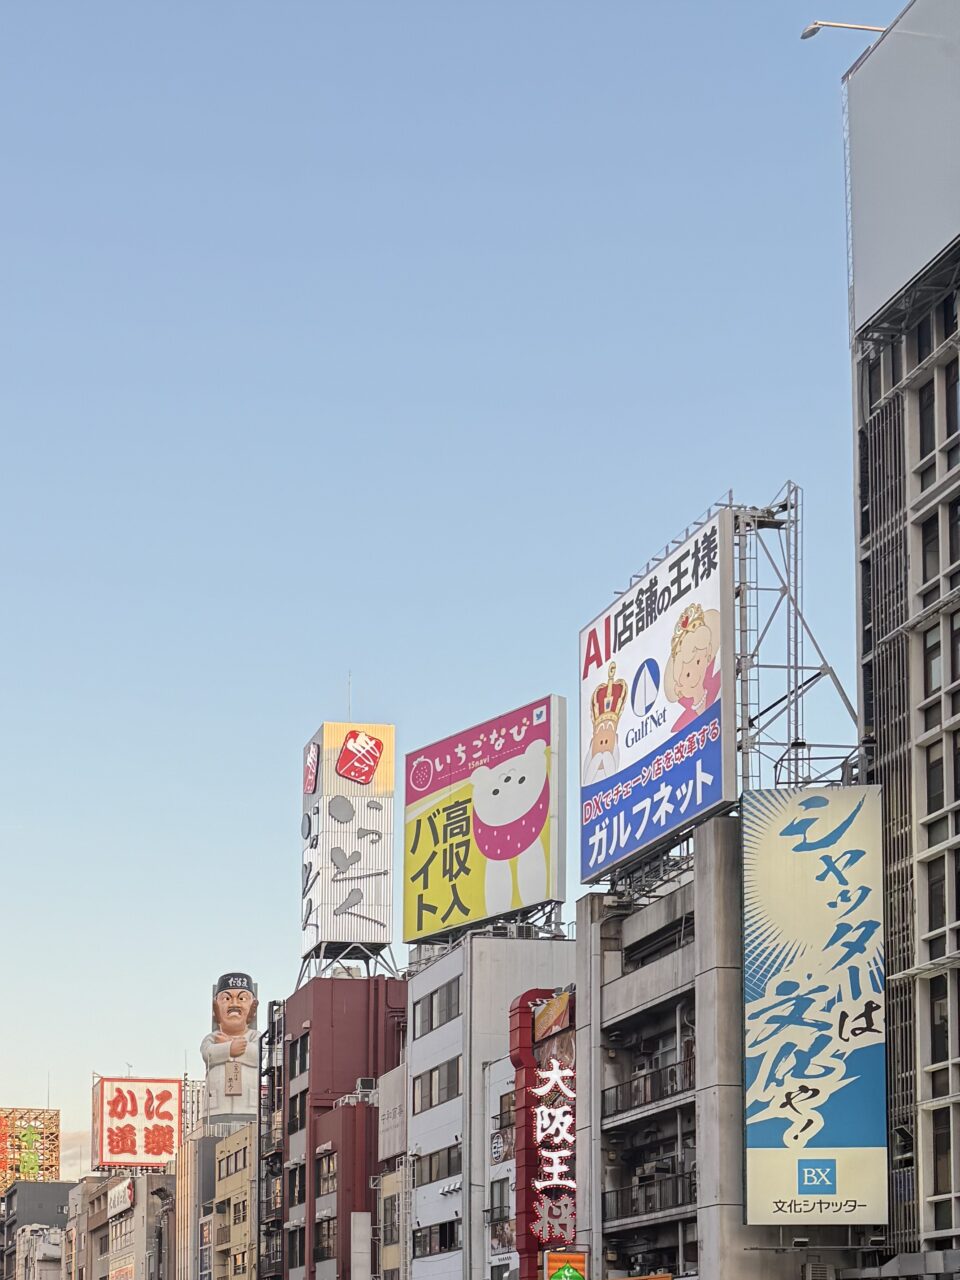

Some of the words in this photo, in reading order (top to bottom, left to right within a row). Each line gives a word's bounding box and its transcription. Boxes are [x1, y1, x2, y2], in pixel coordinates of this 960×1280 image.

[582, 526, 720, 681] AI店舗の王様
[434, 716, 530, 773] いちごなび
[582, 719, 722, 825] DXでチェーン店を改革する
[409, 810, 442, 932] バイト
[441, 797, 474, 924] 高収入
[588, 771, 716, 869] ガルフネット
[107, 1087, 174, 1119] かに
[107, 1124, 175, 1156] 道楽
[531, 1058, 577, 1242] 大阪王将
[802, 1168, 833, 1187] BX
